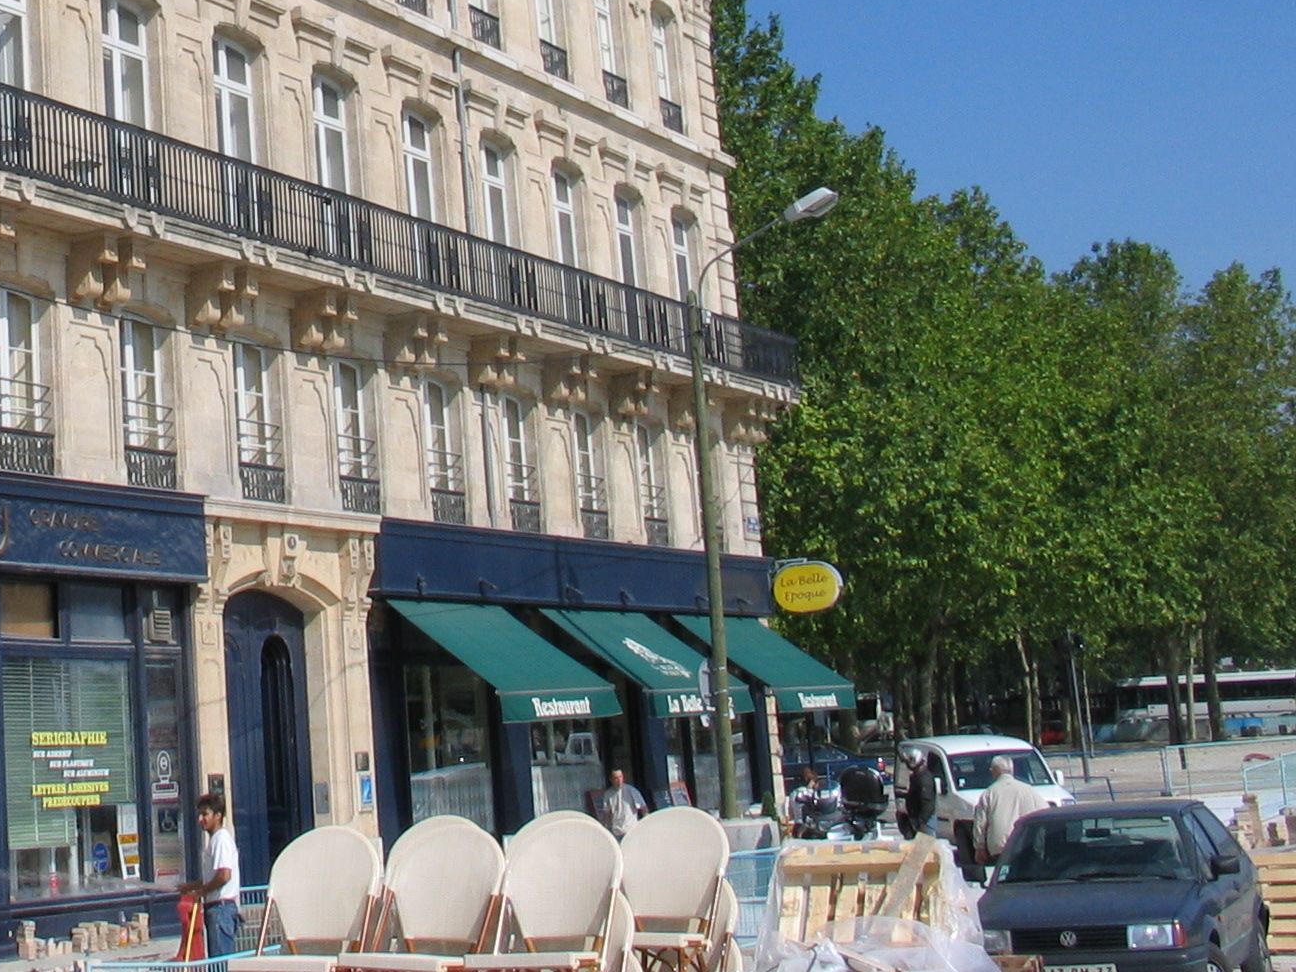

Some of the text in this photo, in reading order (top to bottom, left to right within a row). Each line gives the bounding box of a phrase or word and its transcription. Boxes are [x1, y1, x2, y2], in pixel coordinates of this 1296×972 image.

[779, 576, 797, 588] La
[531, 695, 592, 718] Restaurant
[31, 730, 108, 746] SERIGRAPHIE
